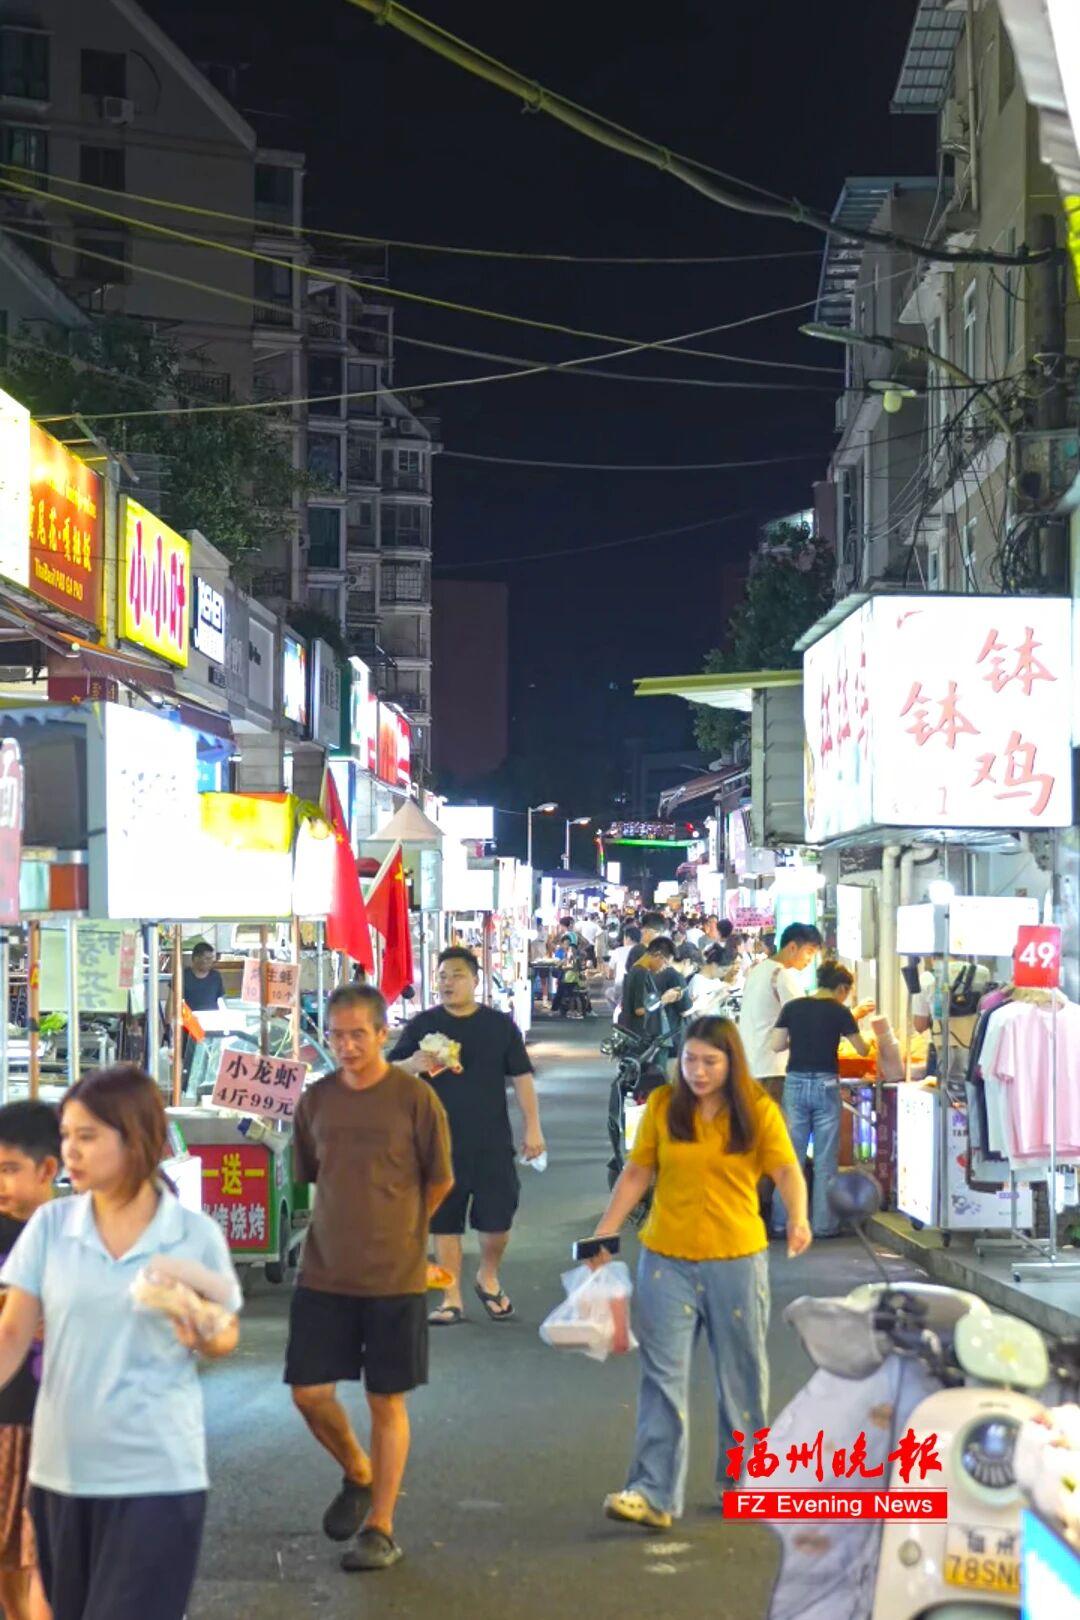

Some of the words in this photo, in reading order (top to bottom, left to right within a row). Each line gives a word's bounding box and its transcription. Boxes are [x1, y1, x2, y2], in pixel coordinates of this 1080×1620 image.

[1019, 941, 1056, 969] 49
[226, 1055, 298, 1089] 小龙虾
[217, 1087, 293, 1116] 4斤99元
